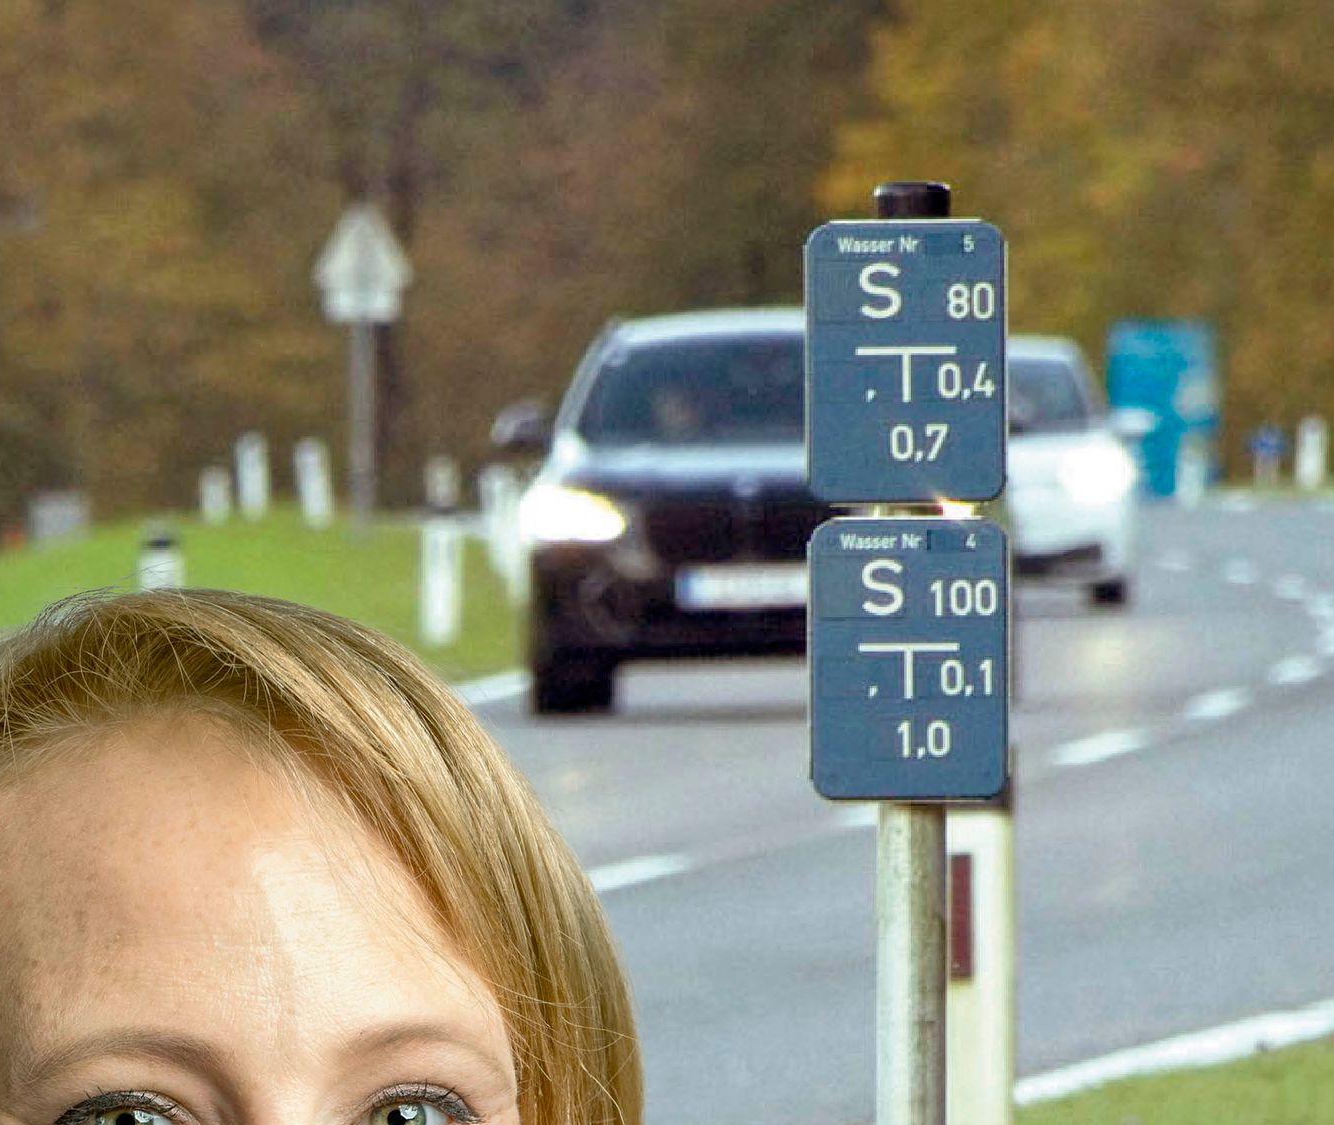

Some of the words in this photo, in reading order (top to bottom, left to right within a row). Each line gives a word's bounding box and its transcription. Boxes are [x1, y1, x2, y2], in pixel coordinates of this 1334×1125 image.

[838, 237, 895, 254] Wasser
[898, 236, 919, 253] Nr
[963, 235, 975, 253] 5
[858, 262, 902, 319] S
[946, 282, 995, 319] 80
[938, 362, 995, 401] 0,4
[889, 423, 949, 462] 0,7
[840, 533, 897, 551] Wasser
[901, 533, 922, 549] Nr
[965, 533, 977, 549] 4
[861, 559, 904, 616] S
[930, 579, 997, 616] 100
[940, 659, 994, 697] 0,1
[897, 720, 951, 759] 1,0
